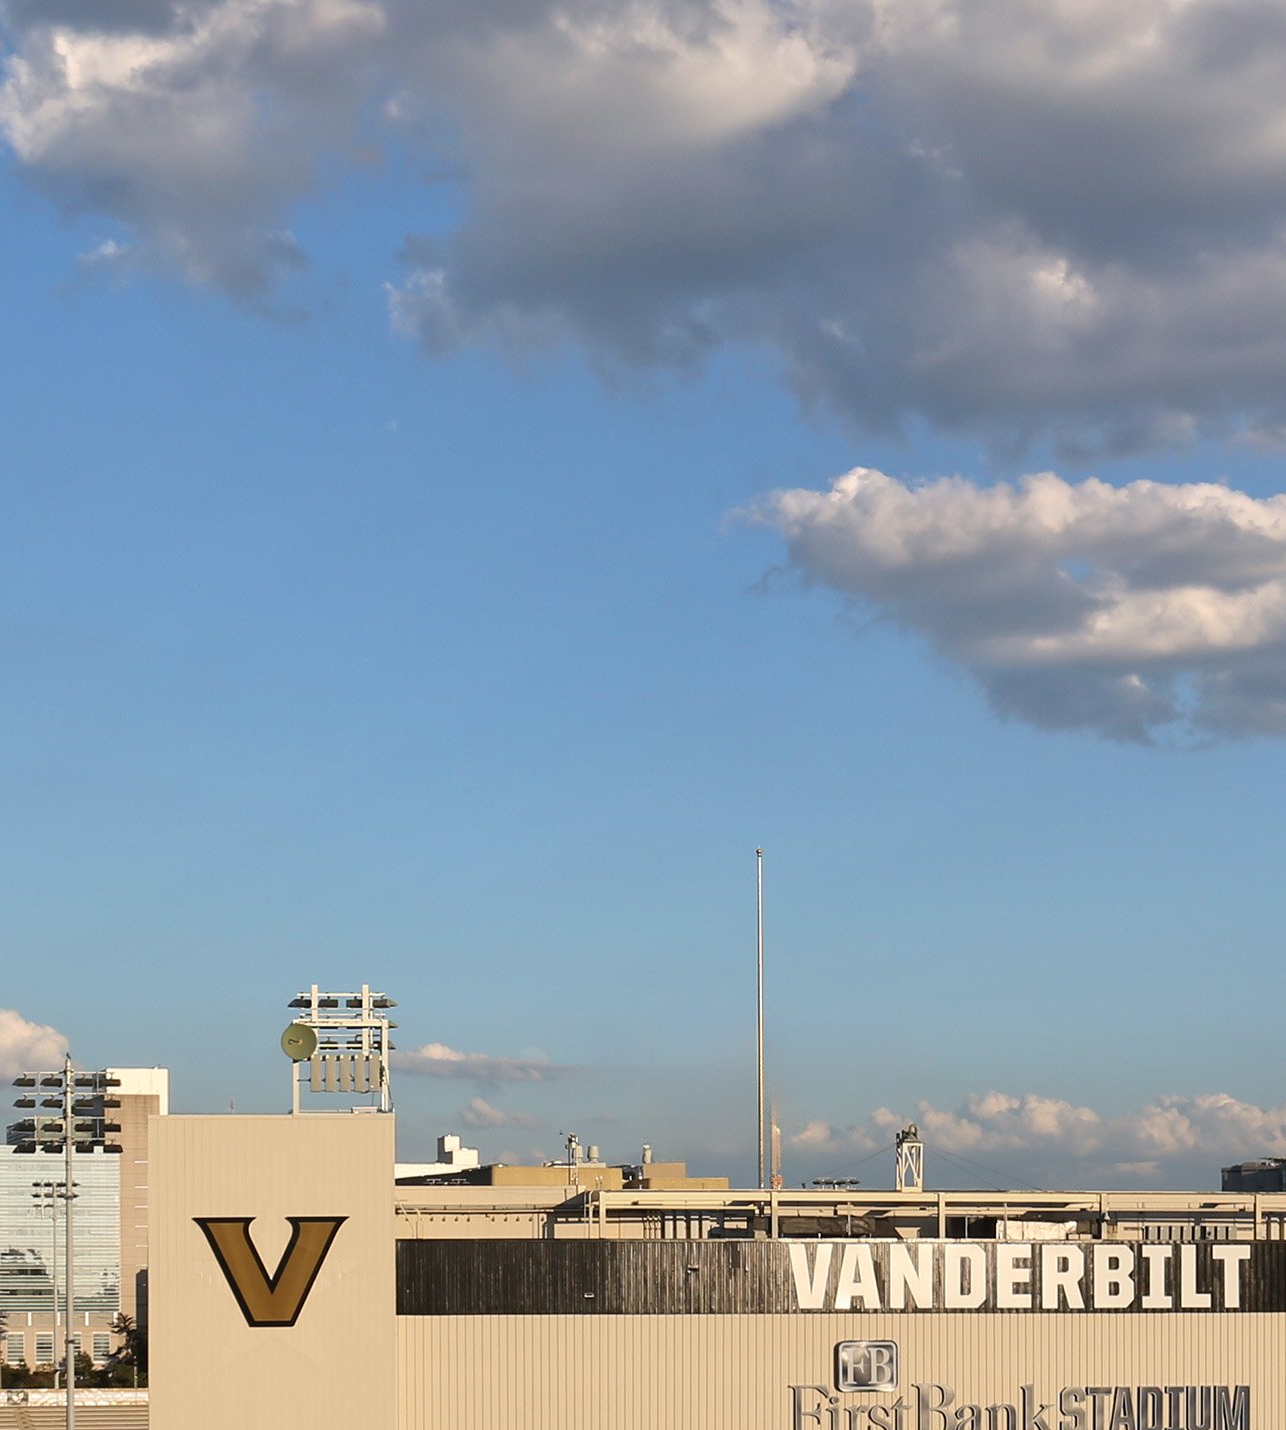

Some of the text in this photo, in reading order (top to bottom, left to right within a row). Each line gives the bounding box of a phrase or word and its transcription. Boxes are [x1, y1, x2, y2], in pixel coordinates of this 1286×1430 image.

[191, 1216, 350, 1327] V
[788, 1243, 1251, 1309] VANDERBILT
[844, 1346, 892, 1385] FB
